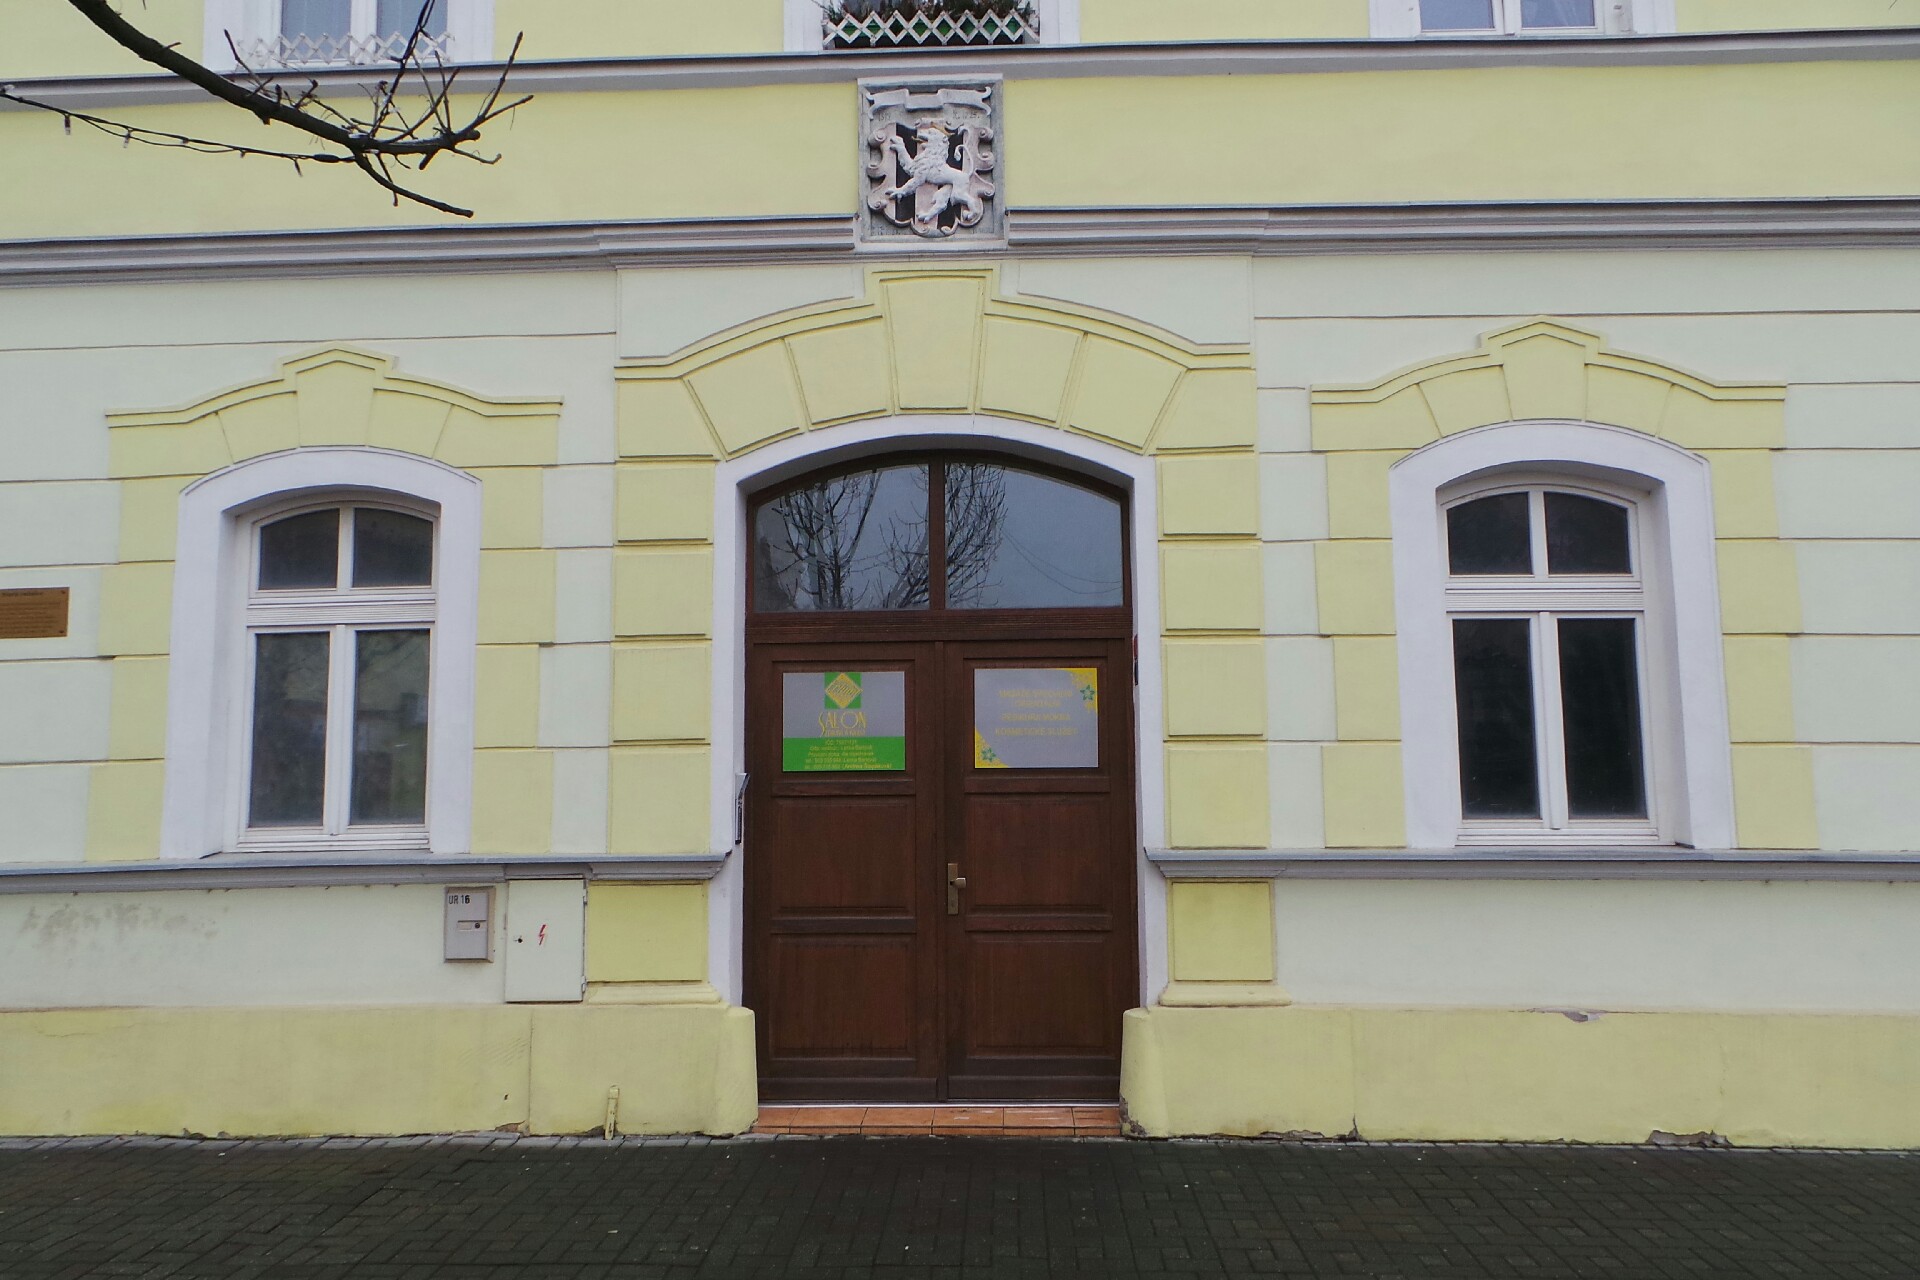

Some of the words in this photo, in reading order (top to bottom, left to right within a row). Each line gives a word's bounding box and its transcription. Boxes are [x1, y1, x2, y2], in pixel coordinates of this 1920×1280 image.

[818, 711, 867, 737] SALON
[448, 895, 459, 905] UR
[461, 895, 470, 904] 16
